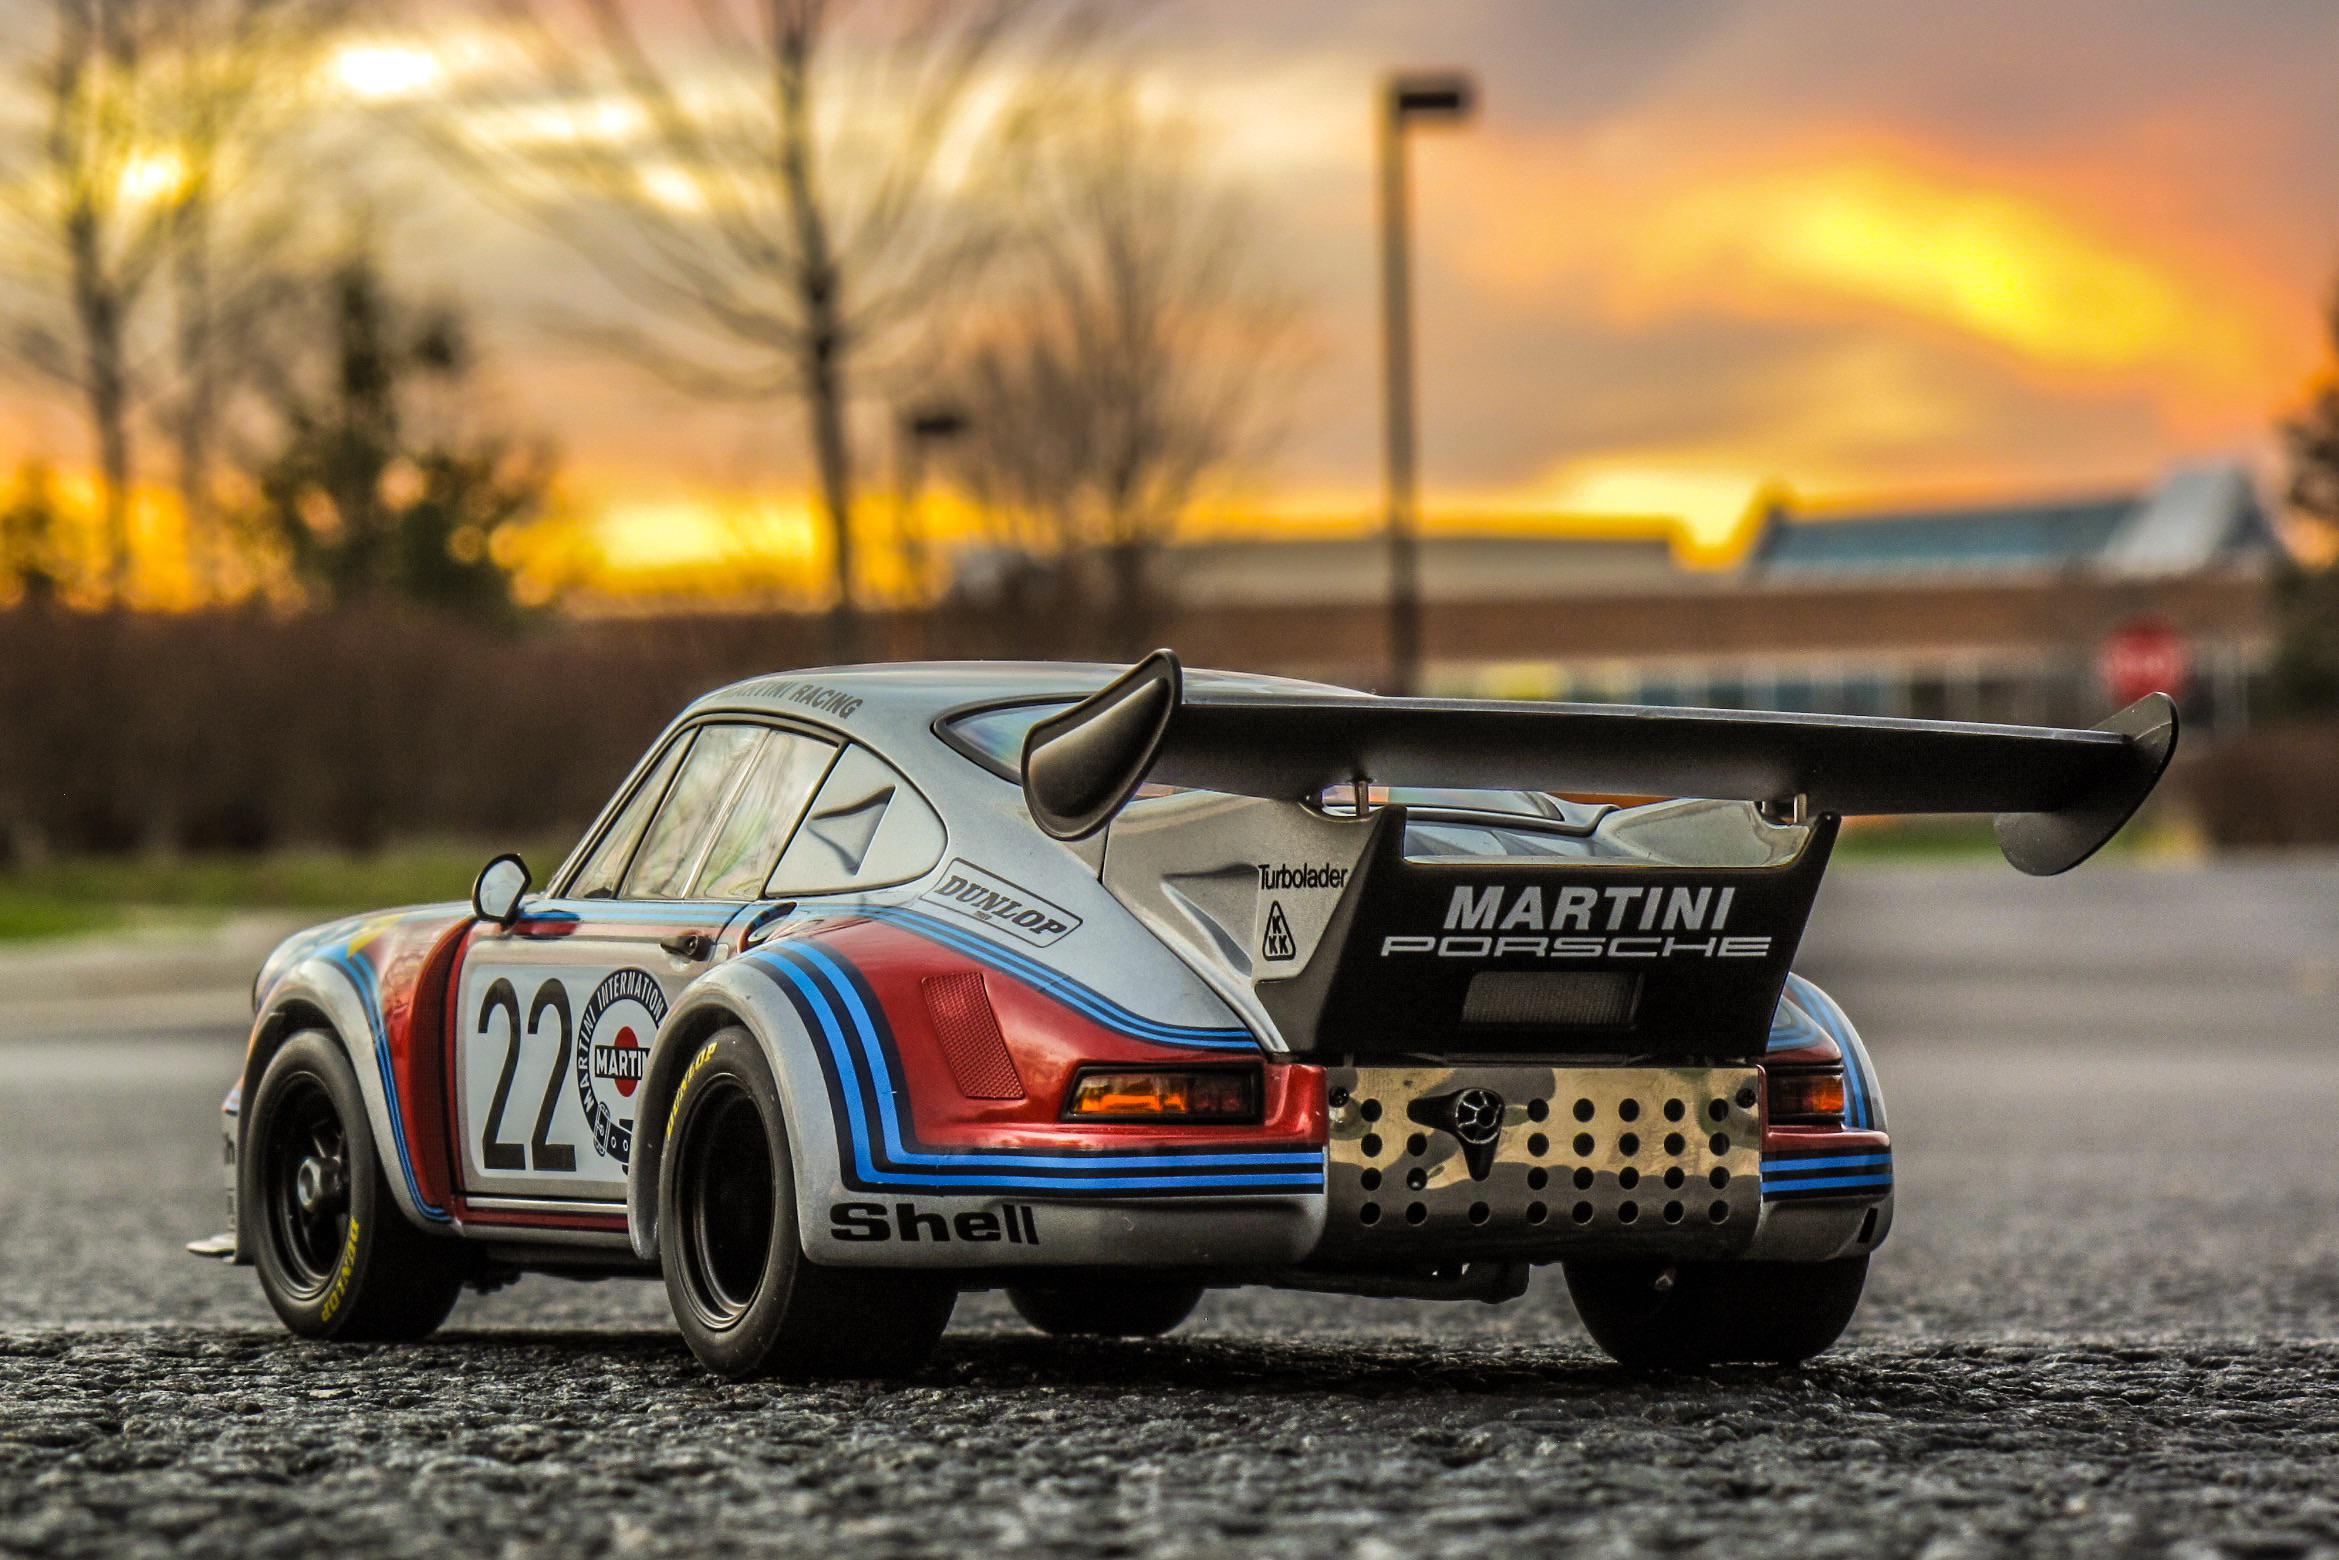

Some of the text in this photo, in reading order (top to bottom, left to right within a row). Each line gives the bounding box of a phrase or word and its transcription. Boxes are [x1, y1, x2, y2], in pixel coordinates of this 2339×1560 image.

[722, 680, 864, 719] RTINI RACING
[1258, 862, 1348, 889] Turbolader
[934, 875, 1068, 934] DUNLOP
[1271, 915, 1282, 934] K
[1443, 886, 1736, 930] MARTINI
[1381, 936, 1772, 957] PORSCHE
[478, 977, 577, 1171] 22
[578, 1004, 597, 1113] MARTINI
[666, 1041, 719, 1141] DUNLOP
[829, 1202, 1040, 1245] Shell
